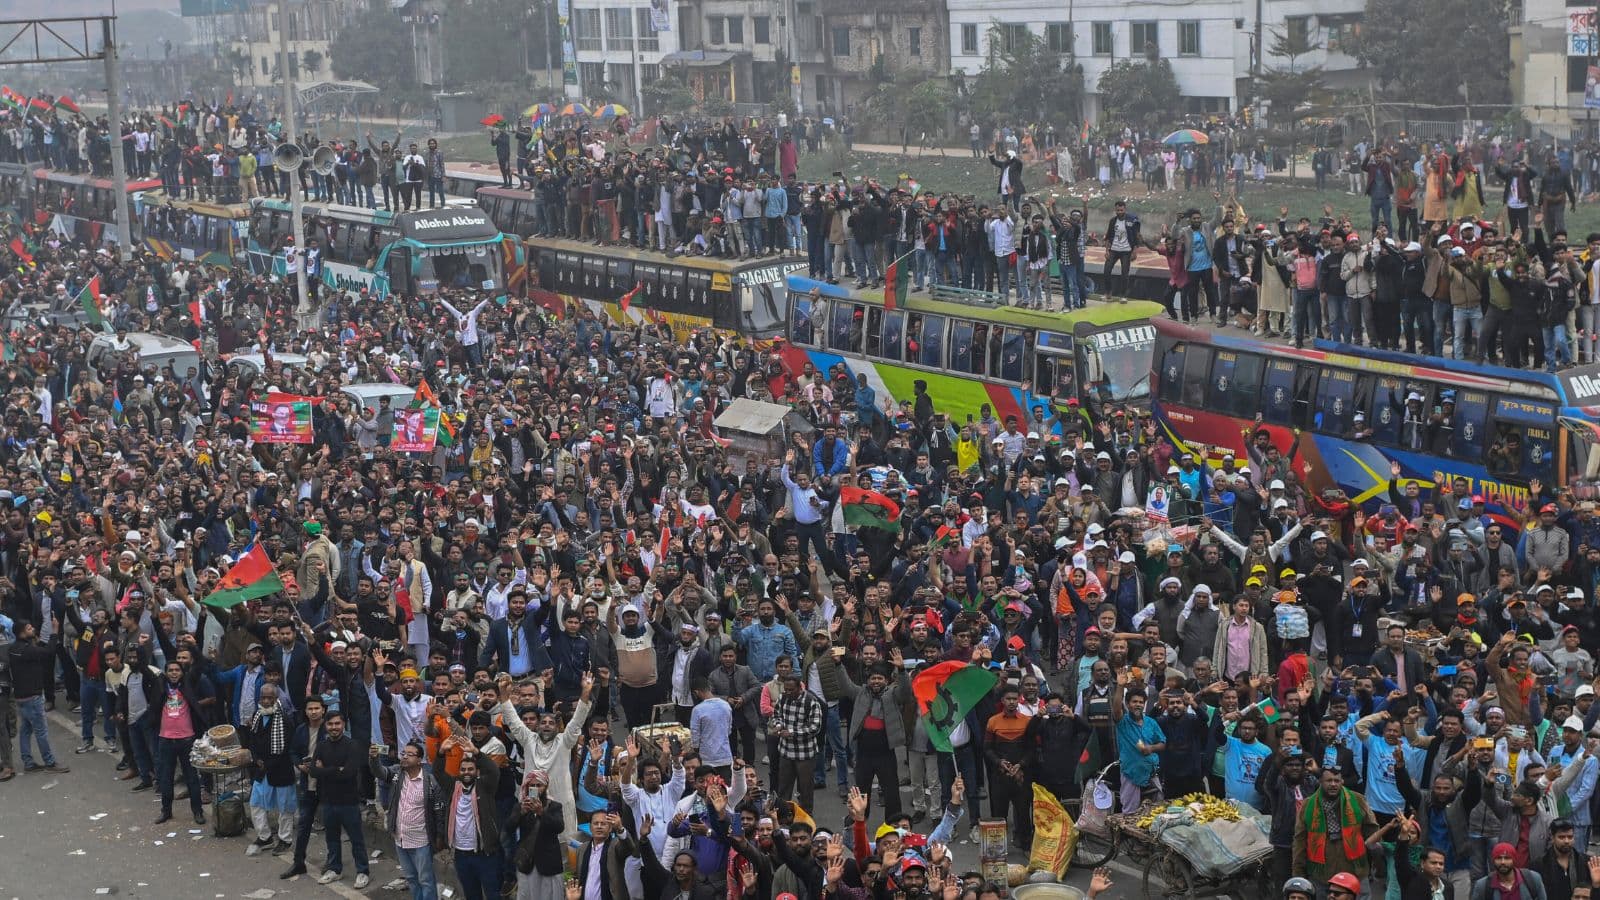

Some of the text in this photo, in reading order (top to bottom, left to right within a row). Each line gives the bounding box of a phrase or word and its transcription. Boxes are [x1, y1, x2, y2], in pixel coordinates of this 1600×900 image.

[414, 216, 485, 230] Allahu Akbar
[1569, 372, 1600, 399] Alla
